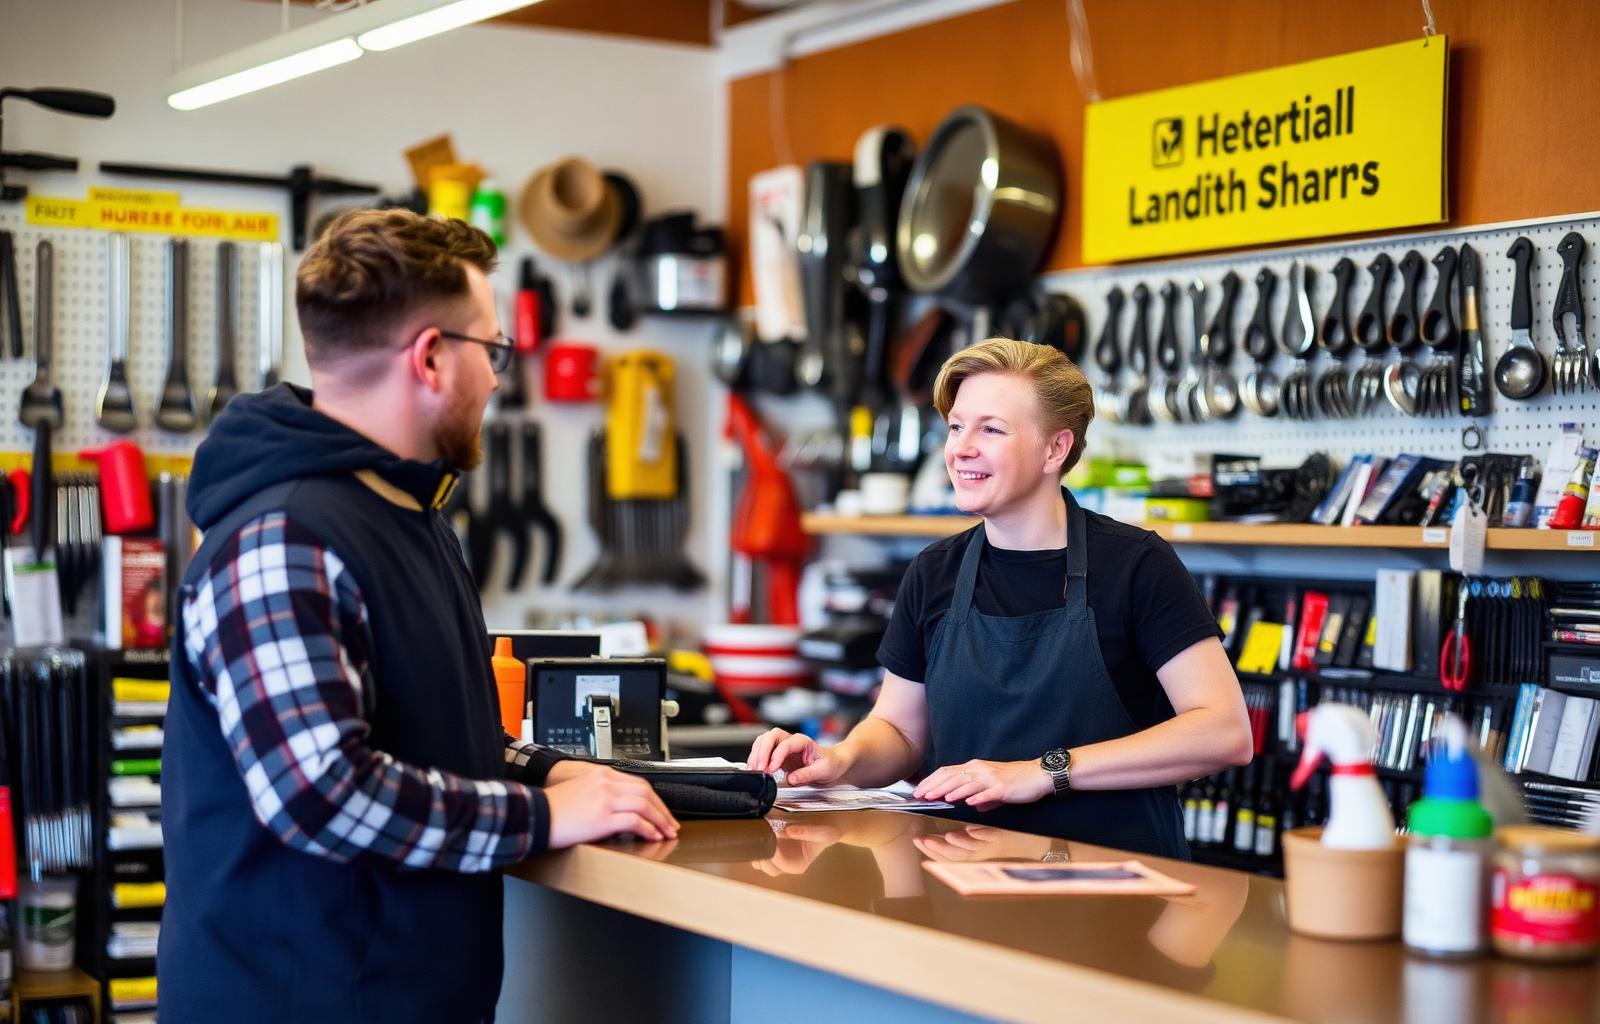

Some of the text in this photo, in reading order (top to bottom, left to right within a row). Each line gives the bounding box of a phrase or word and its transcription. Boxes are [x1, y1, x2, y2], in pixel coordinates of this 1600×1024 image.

[1197, 86, 1355, 158] Hetertiall
[1129, 161, 1380, 226] Landith Sharrs
